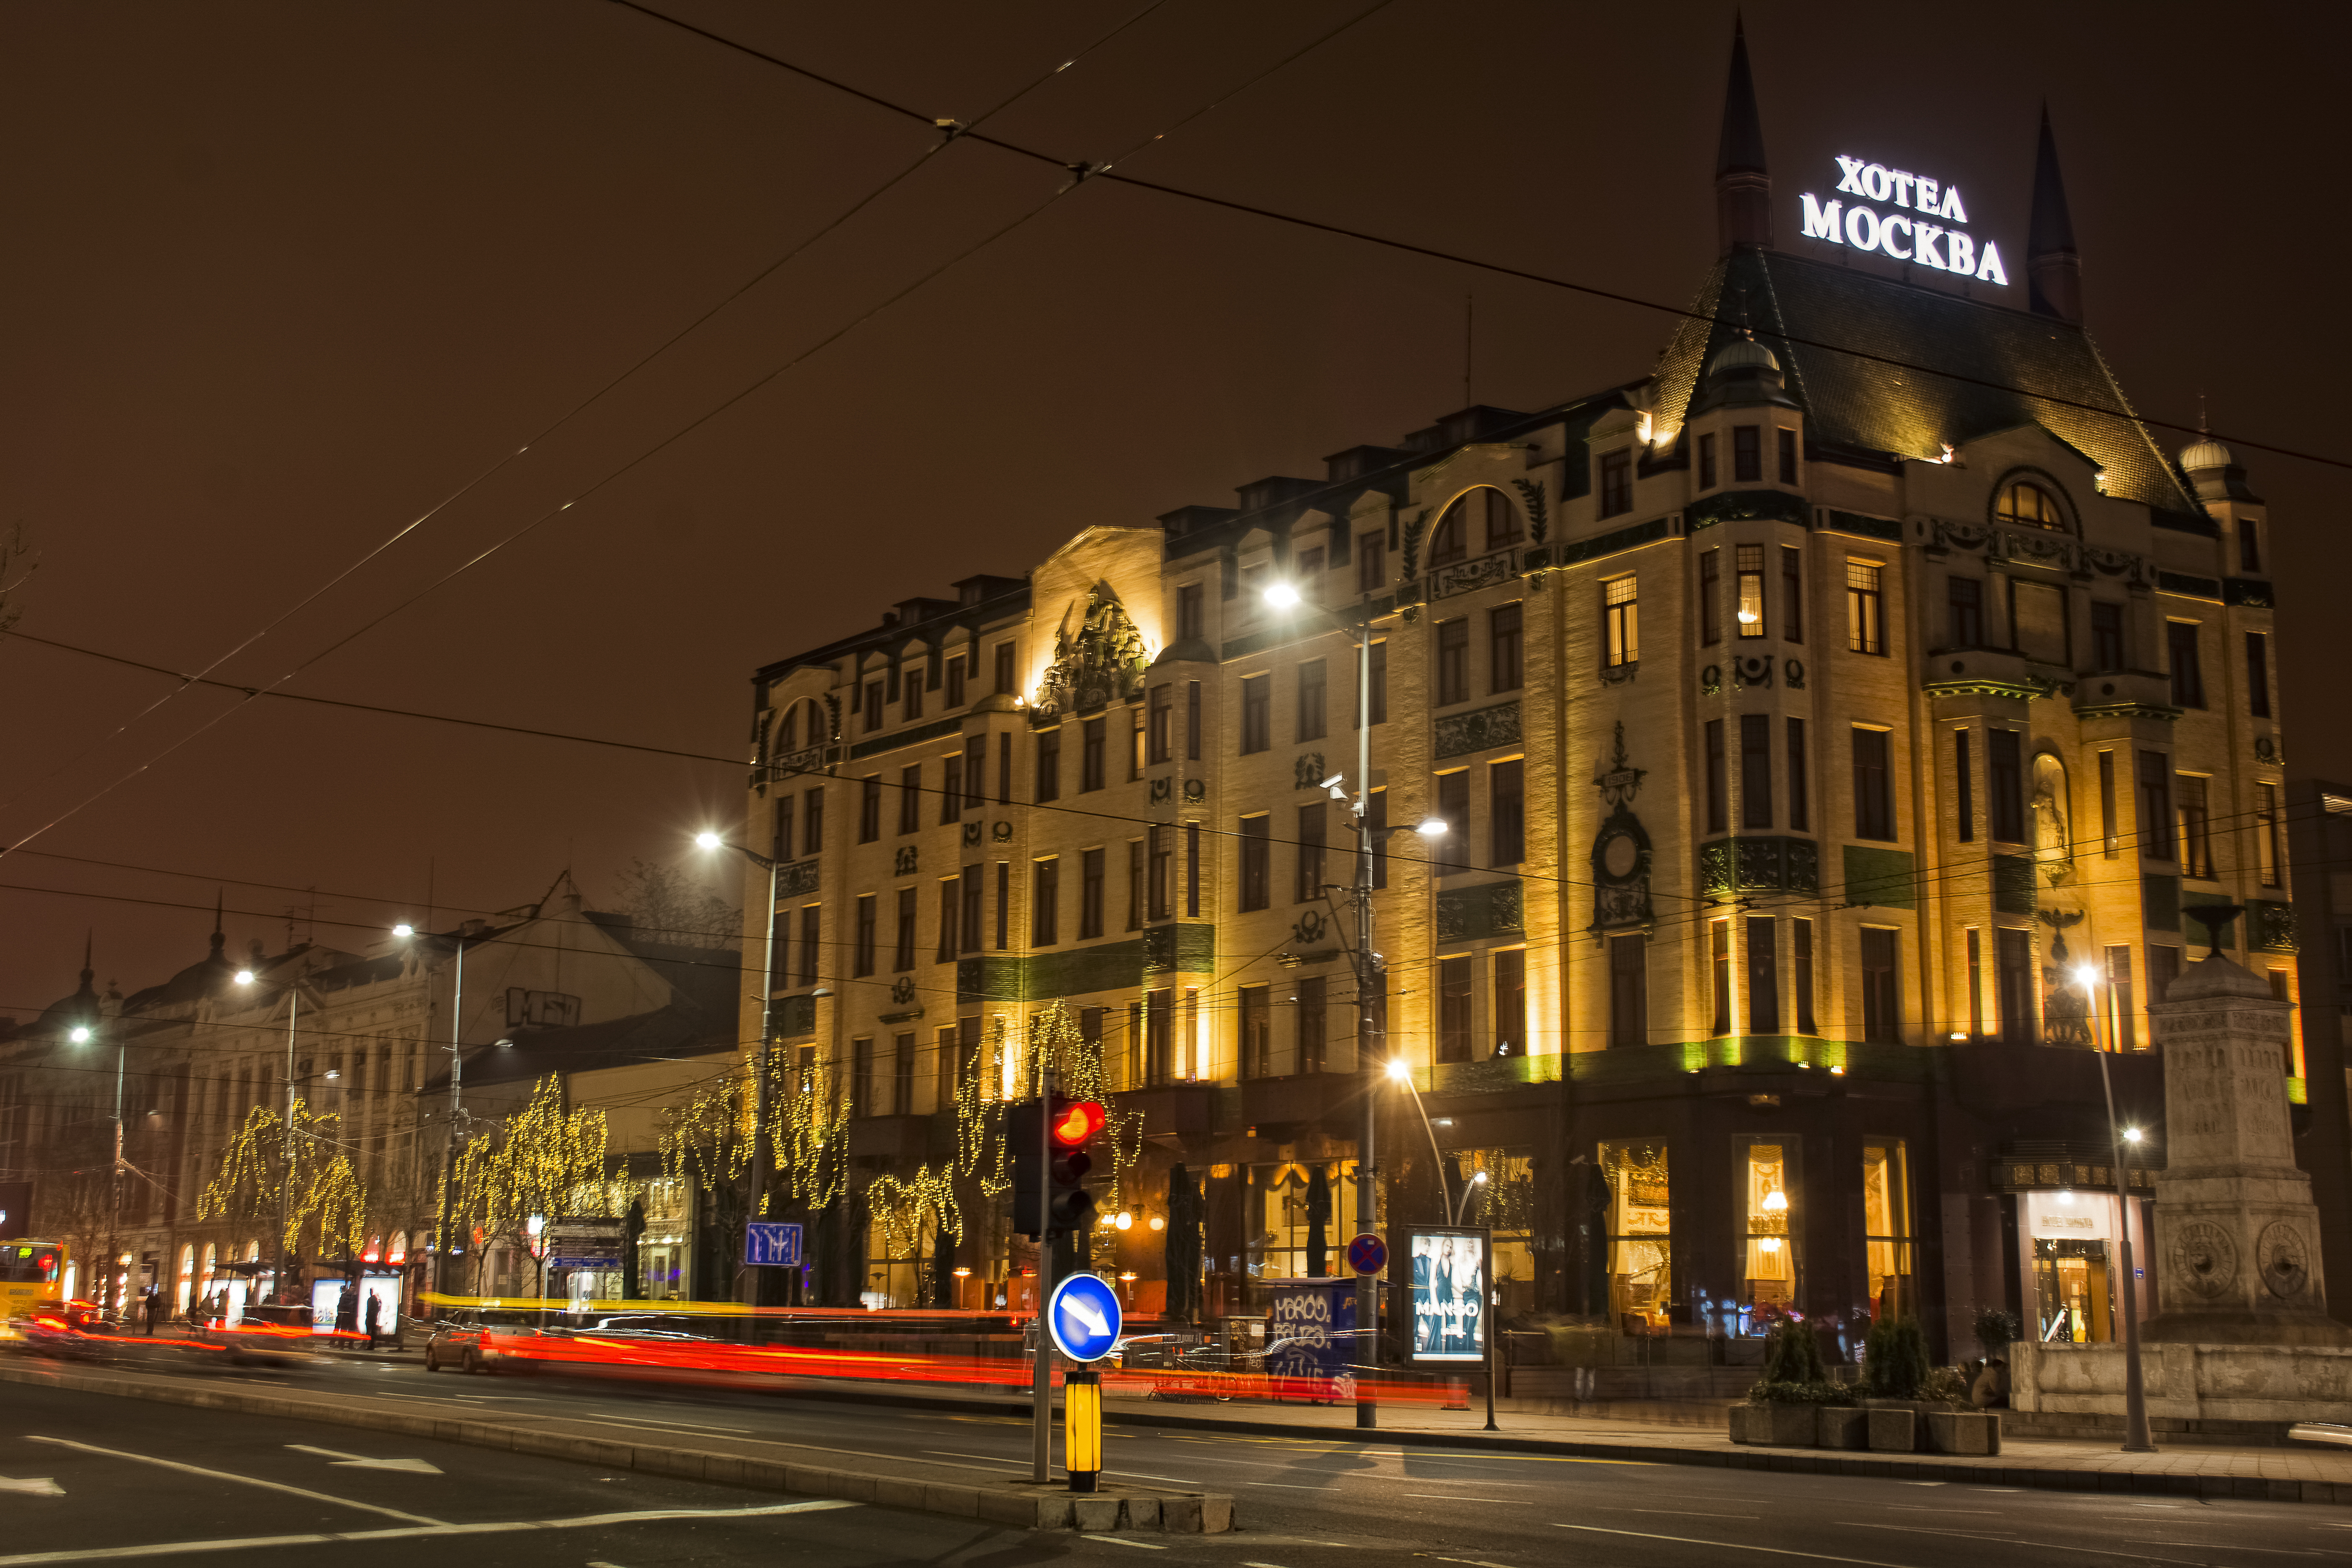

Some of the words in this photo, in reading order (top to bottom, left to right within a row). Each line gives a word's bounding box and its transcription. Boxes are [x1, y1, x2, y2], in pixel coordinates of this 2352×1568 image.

[1835, 155, 1968, 223] ХОТЕЛ
[1799, 192, 2009, 286] МОСКВА
[1608, 773, 1632, 785] 1906
